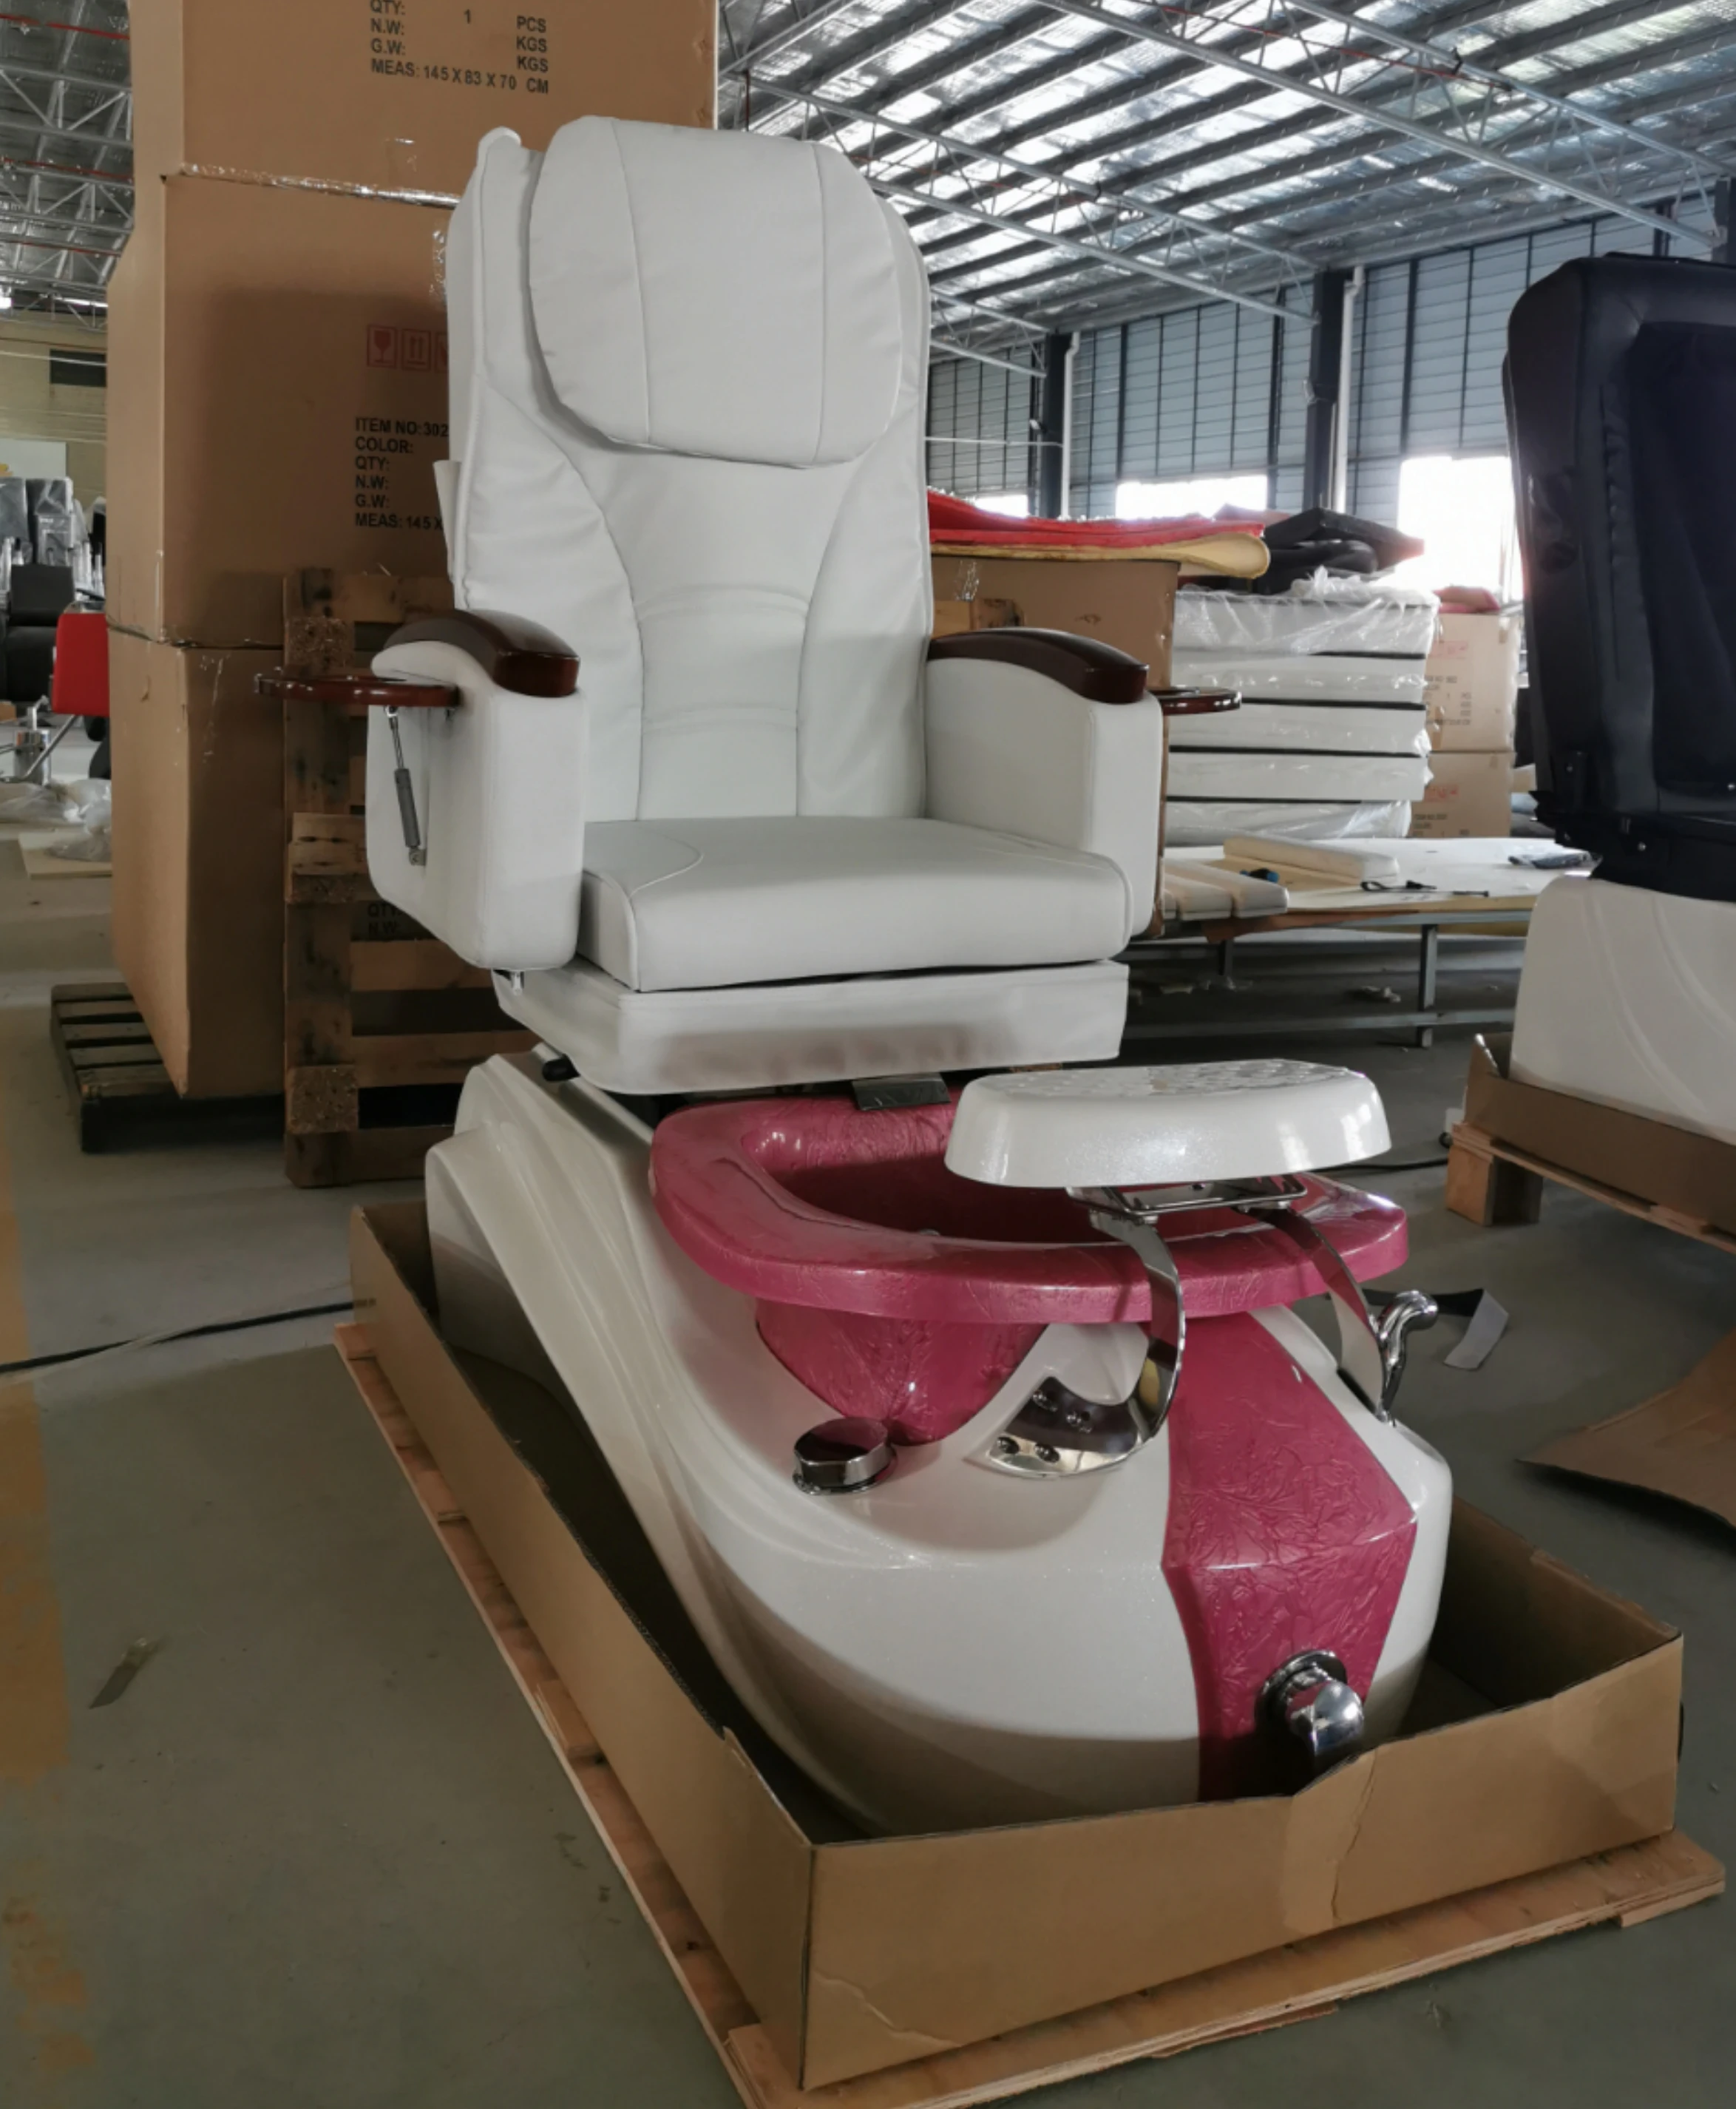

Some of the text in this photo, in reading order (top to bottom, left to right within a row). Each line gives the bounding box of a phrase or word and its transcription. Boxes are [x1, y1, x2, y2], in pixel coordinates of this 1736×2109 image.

[370, 0, 546, 33] QTY: 1 PCS
[370, 18, 547, 53] N.W: KGS
[370, 38, 549, 73] G.W: KGS
[370, 58, 421, 78] MEAS:
[424, 65, 450, 81] 145
[500, 74, 517, 90] 70
[526, 76, 549, 95] CM
[356, 416, 391, 433] ITEM
[355, 436, 414, 454] COLOR:
[355, 456, 390, 471] QTY:
[355, 475, 390, 490] N.W:
[355, 494, 390, 509] G.W:
[355, 512, 403, 528] MEAS:
[407, 515, 431, 530] 145
